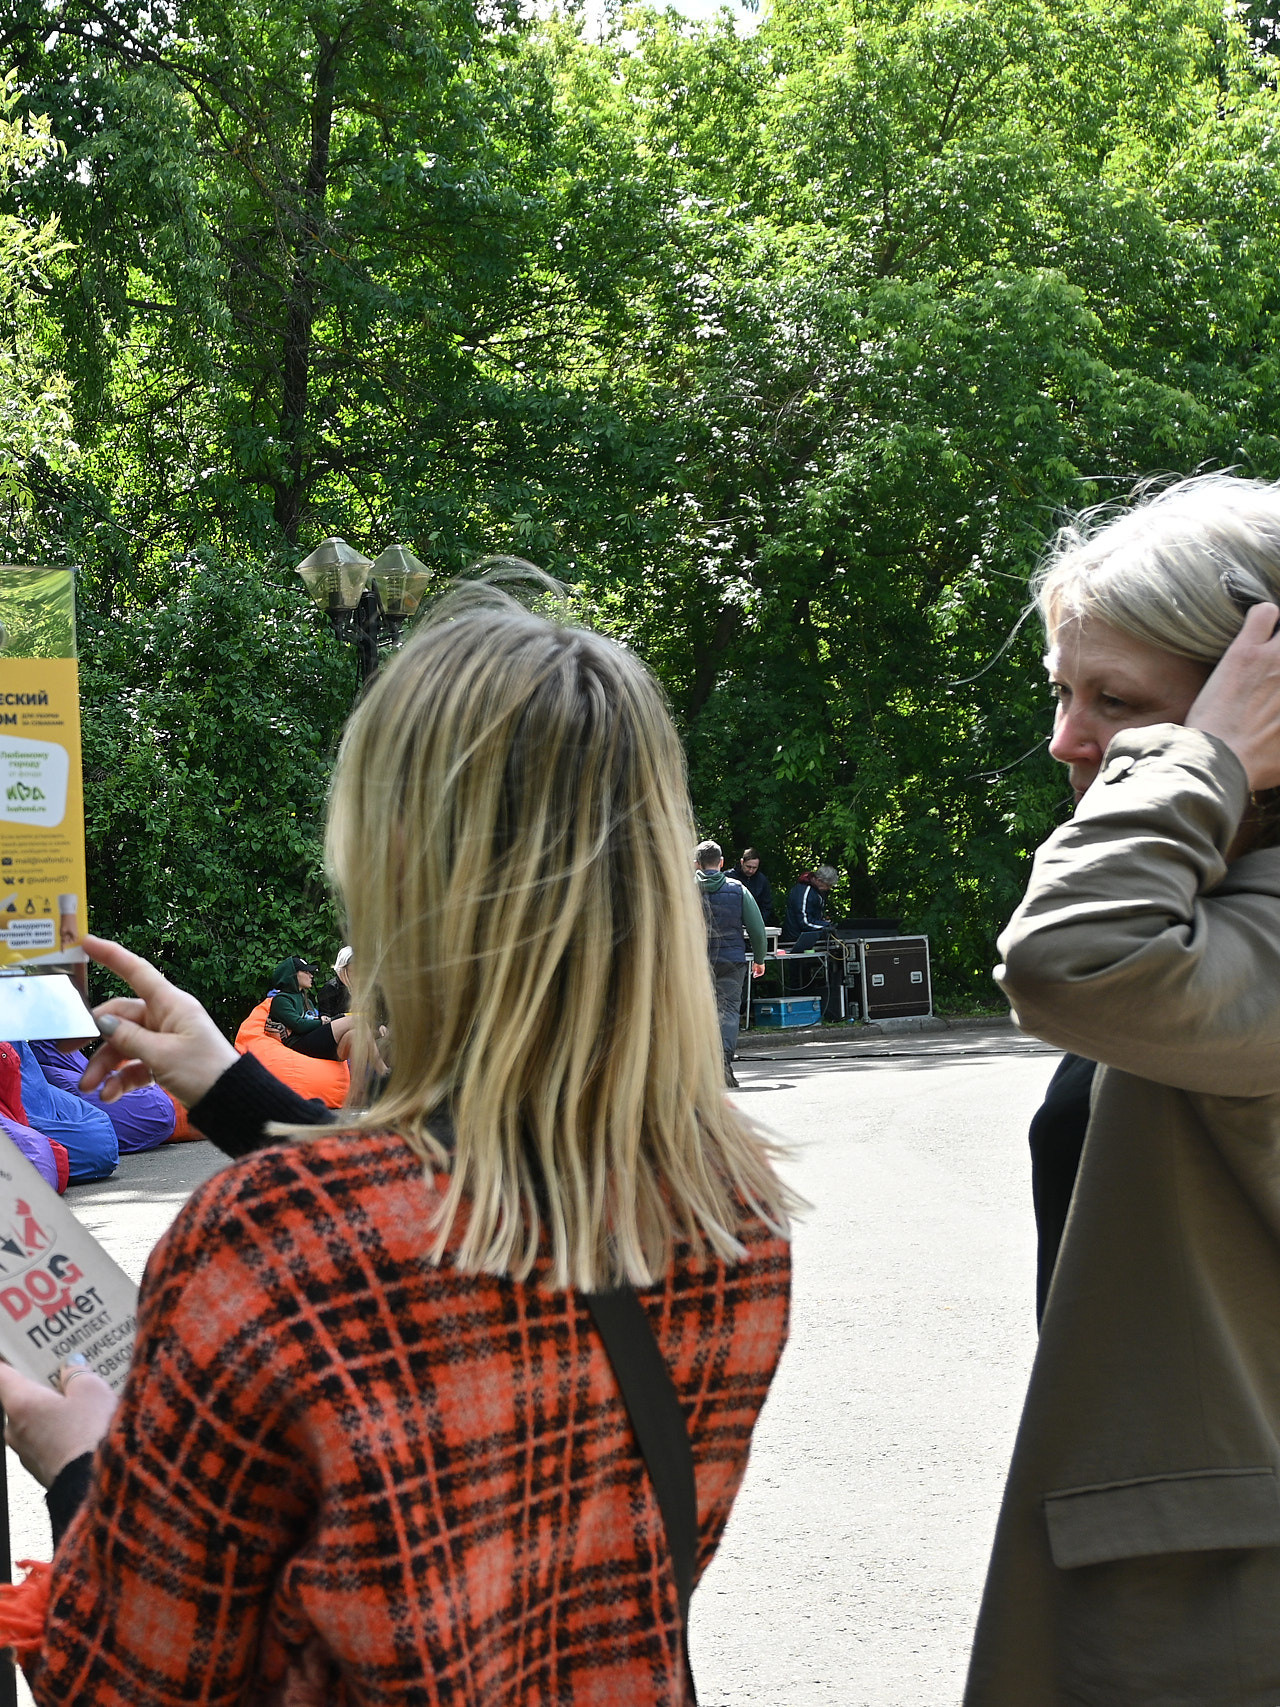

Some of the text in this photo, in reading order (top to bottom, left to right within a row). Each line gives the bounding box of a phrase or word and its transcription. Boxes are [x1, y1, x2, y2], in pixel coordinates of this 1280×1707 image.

[0, 750, 49, 760] Любимому
[8, 761, 41, 769] городу
[26, 1286, 104, 1349] пакет
[51, 1311, 113, 1359] КОМПЛЕКТ
